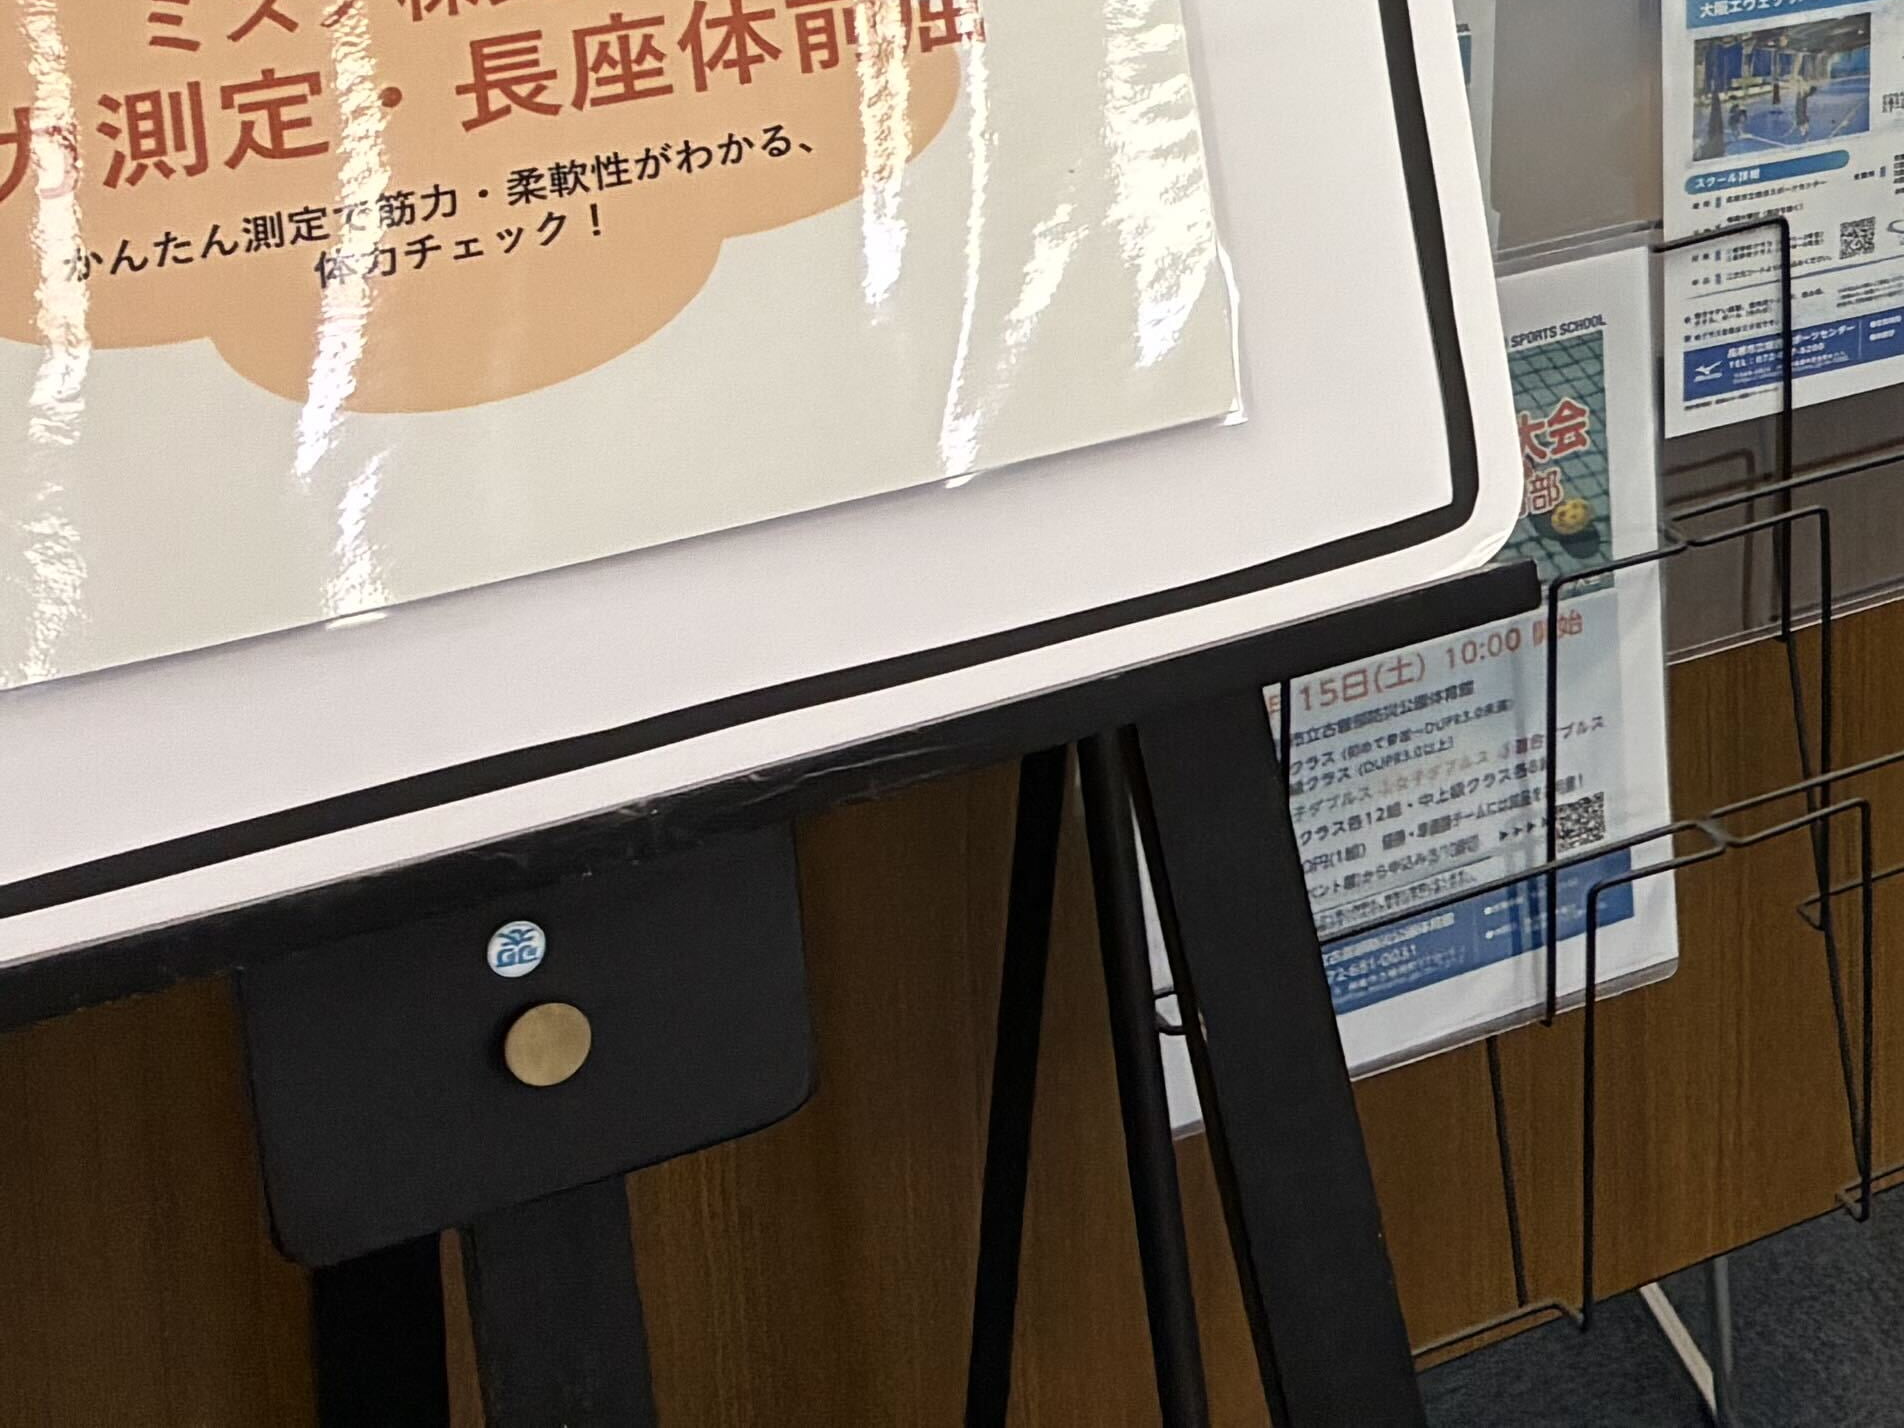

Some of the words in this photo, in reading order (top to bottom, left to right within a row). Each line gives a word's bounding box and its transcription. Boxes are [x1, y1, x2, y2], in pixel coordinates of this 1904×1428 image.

[62, 123, 814, 281] かんたん測定で筋力・柔軟性がわかる、
[314, 202, 603, 289] 体力チェック！
[1510, 324, 1557, 348] SPORTS
[1559, 313, 1608, 336] SCHOOL
[1300, 651, 1426, 712] 15日(土)
[1445, 627, 1522, 669] 10:00
